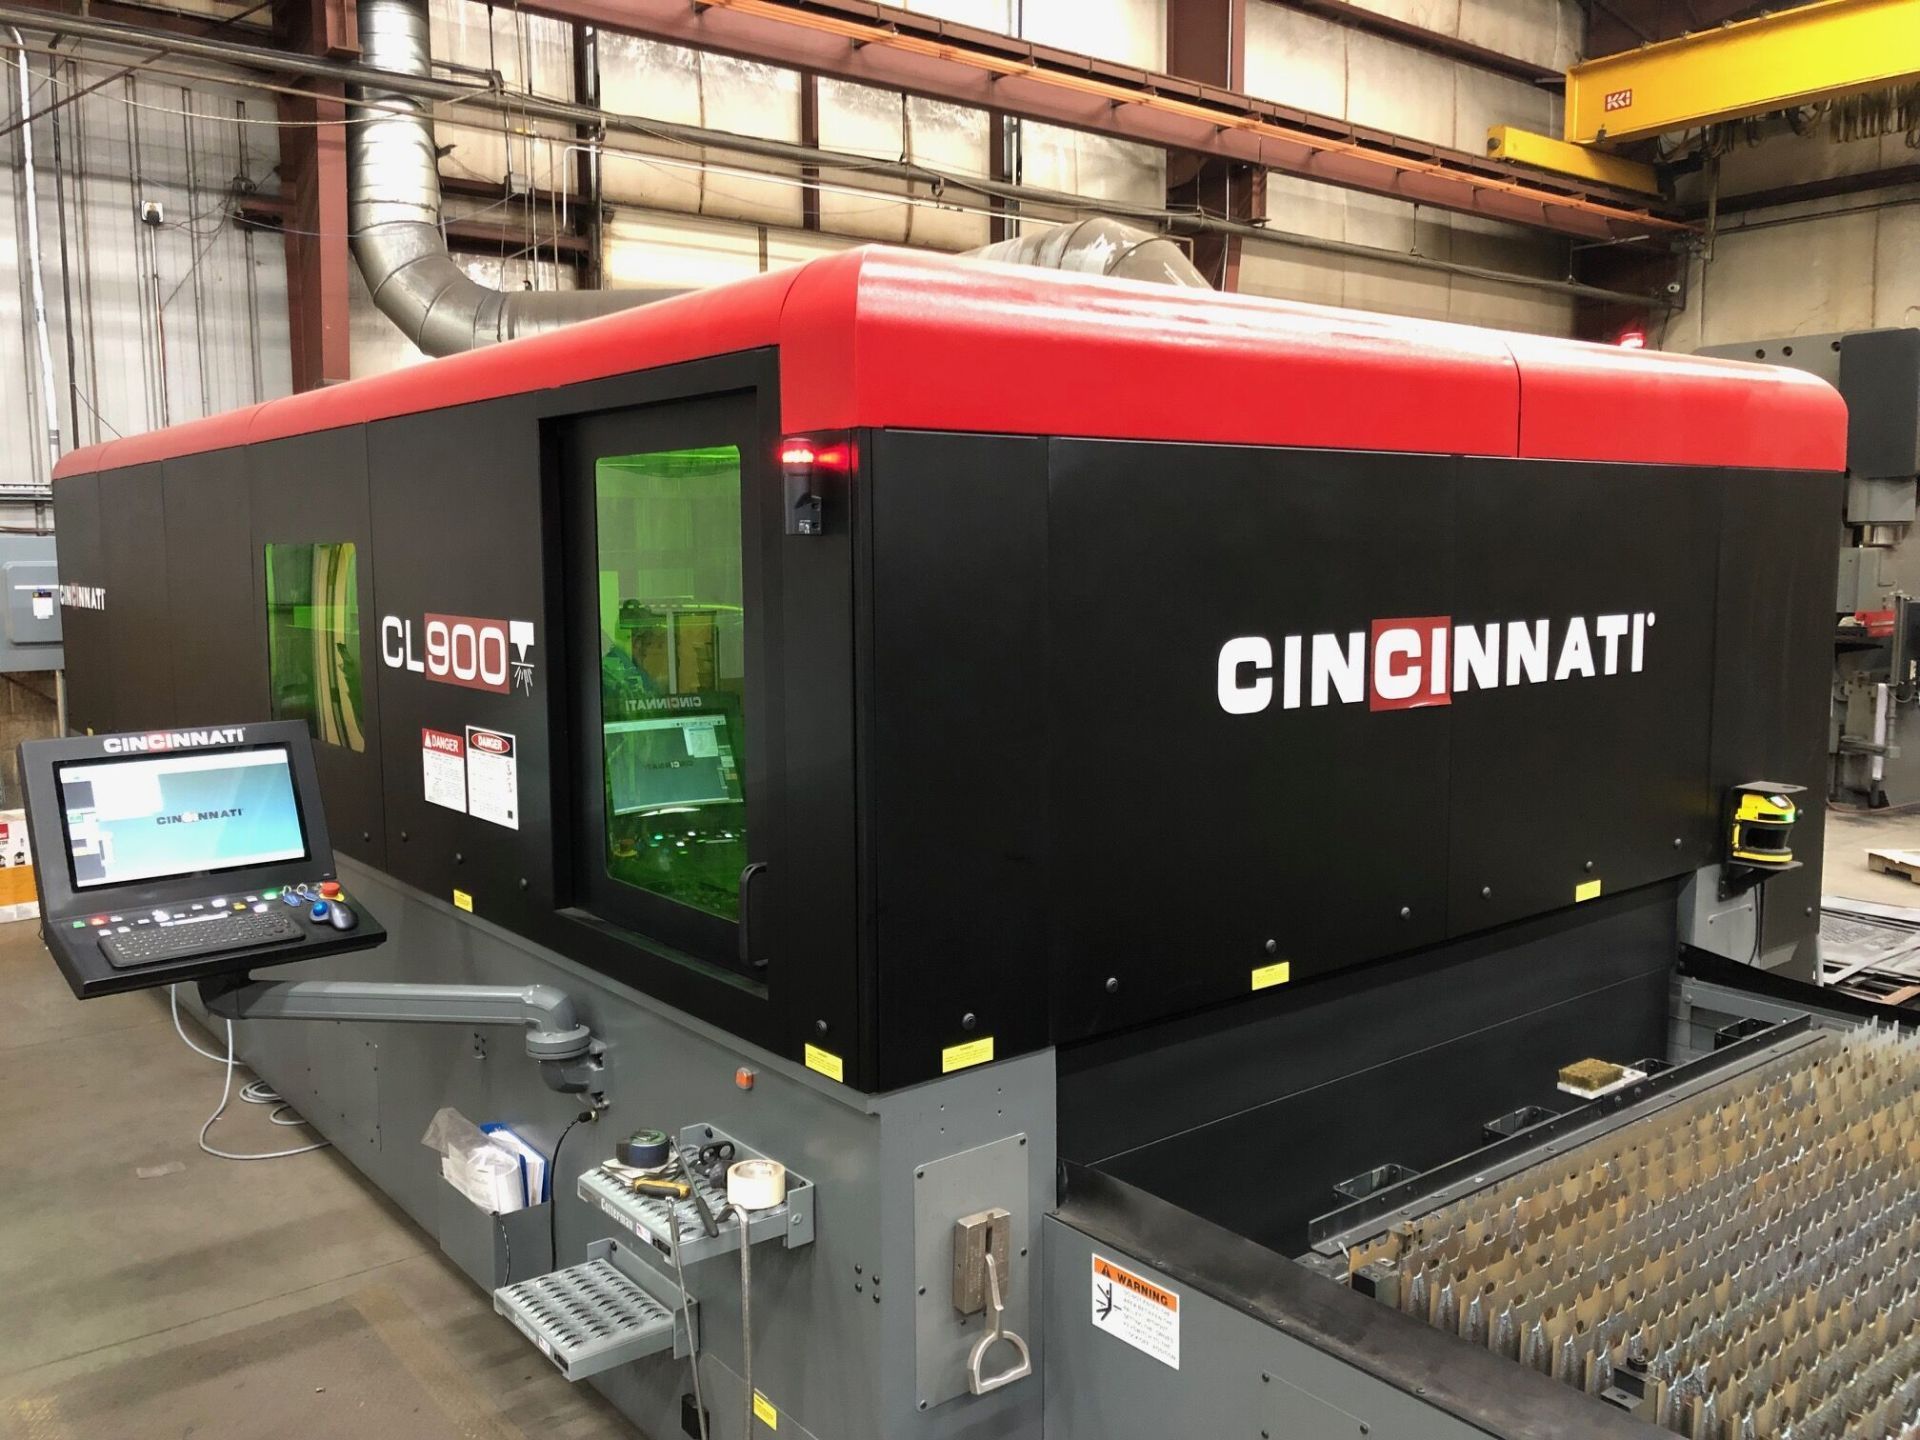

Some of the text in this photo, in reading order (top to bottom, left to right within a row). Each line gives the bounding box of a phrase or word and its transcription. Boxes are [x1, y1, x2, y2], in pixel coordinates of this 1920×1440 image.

[382, 615, 507, 686] CL900
[1218, 613, 1647, 715] CINCINNATI
[103, 728, 244, 753] CINCINNATI
[431, 734, 460, 753] DANGER
[156, 808, 243, 825] CINNNATI
[1117, 1272, 1169, 1306] WARNING
